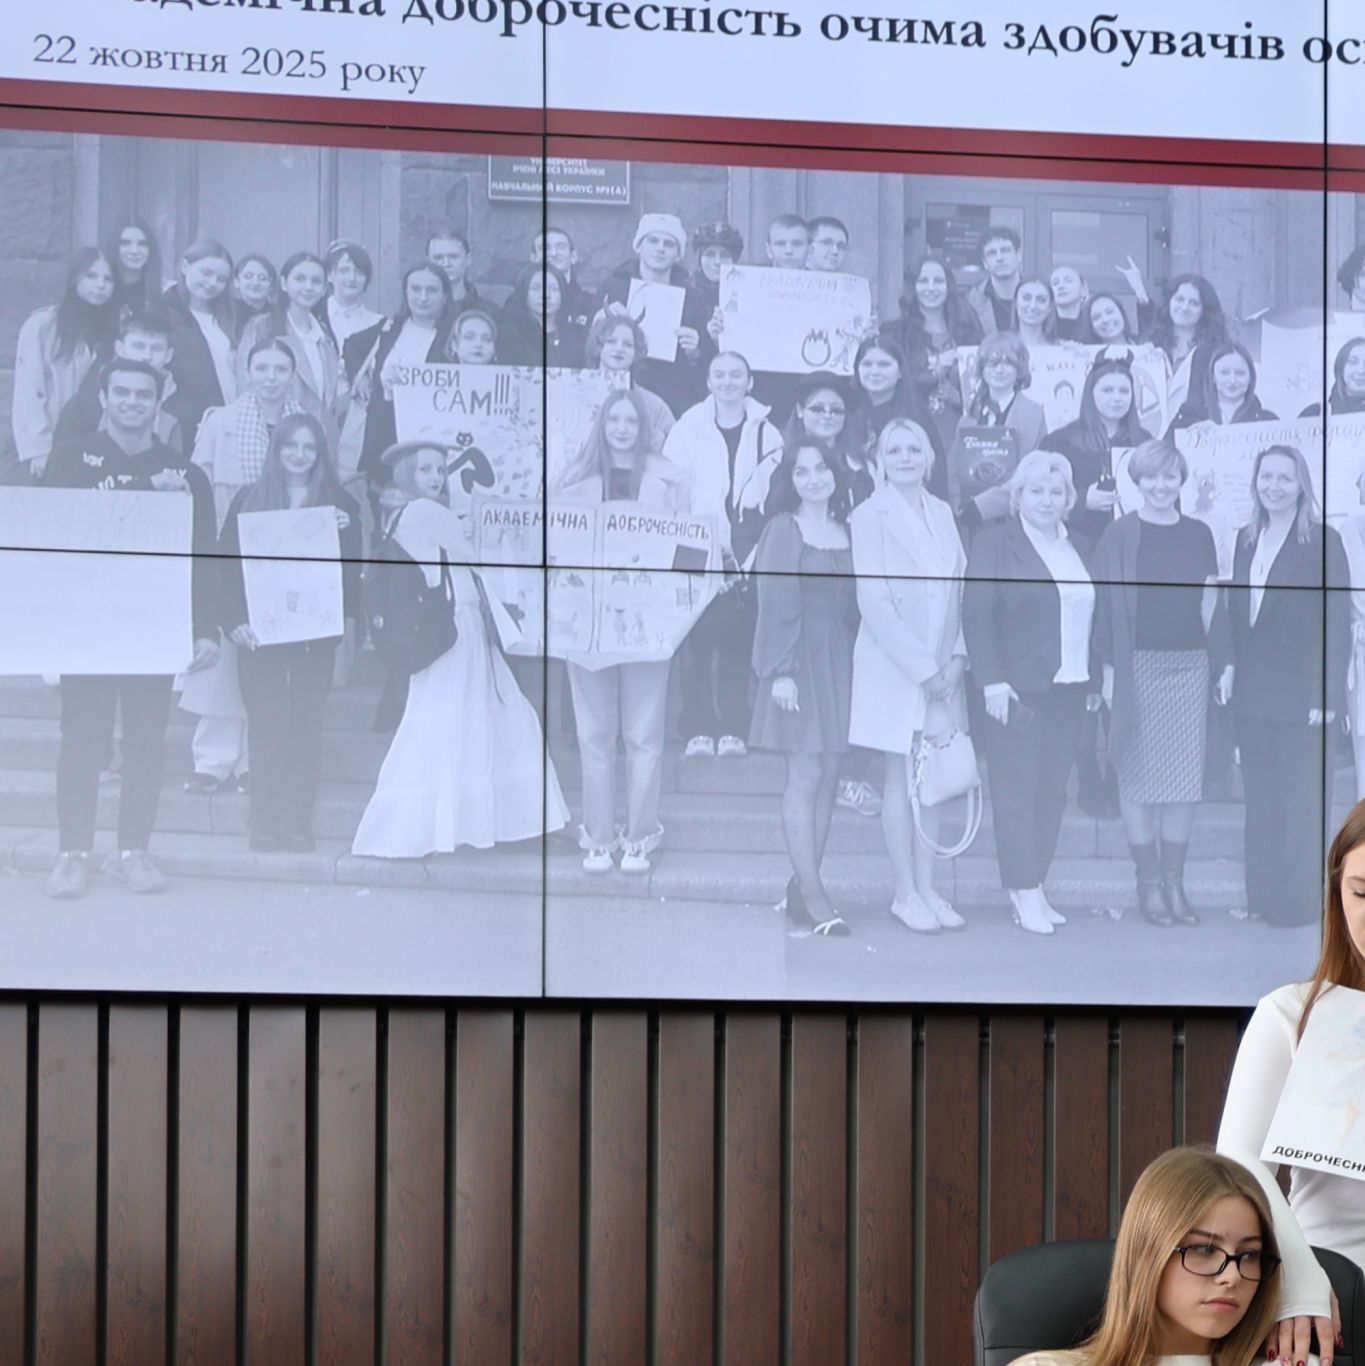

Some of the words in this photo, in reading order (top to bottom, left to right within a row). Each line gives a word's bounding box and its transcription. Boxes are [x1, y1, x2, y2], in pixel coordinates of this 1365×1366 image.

[401, 0, 801, 38] доброчесність
[819, 13, 986, 48] очима
[1003, 14, 1286, 67] здобувачів
[33, 33, 77, 65] 22
[88, 45, 229, 73] жовтня
[240, 47, 327, 79] 2025
[339, 61, 427, 94] року
[399, 367, 461, 388] ЗРОБИ
[606, 514, 710, 540] ДОБРОЧЕСНІСТЬ
